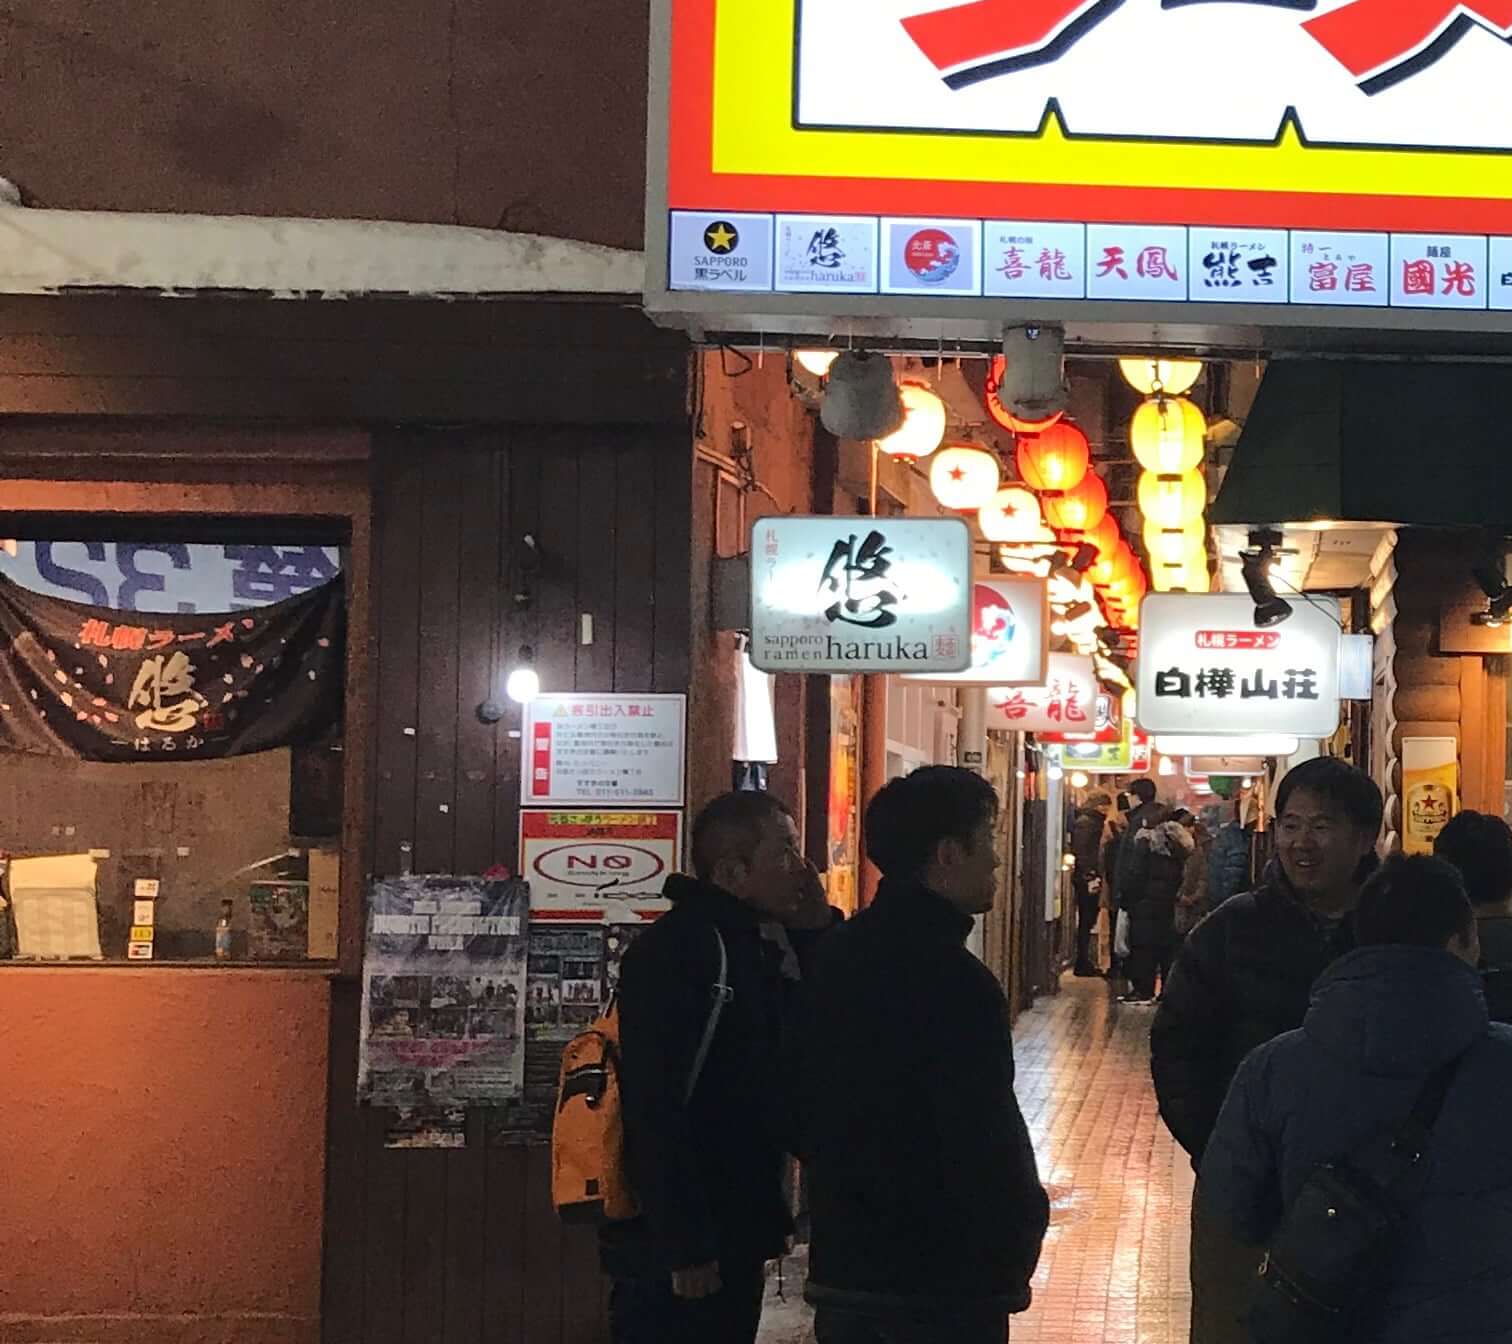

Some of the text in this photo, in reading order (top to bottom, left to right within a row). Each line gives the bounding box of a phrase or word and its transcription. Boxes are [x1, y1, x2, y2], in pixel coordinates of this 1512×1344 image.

[694, 256, 748, 267] SAPPORO
[694, 267, 747, 282] 黒ラベル
[996, 246, 1072, 281] 喜龍
[1096, 246, 1178, 281] 天鳳
[811, 269, 854, 282] haruka
[1402, 259, 1476, 296] 國光
[79, 618, 254, 650] 札幌ラーメ
[764, 634, 928, 660] sapporo haruka
[1197, 632, 1280, 648] 札幌ラーメン
[764, 649, 822, 660] ramen
[1155, 667, 1319, 700] 白樺山荘
